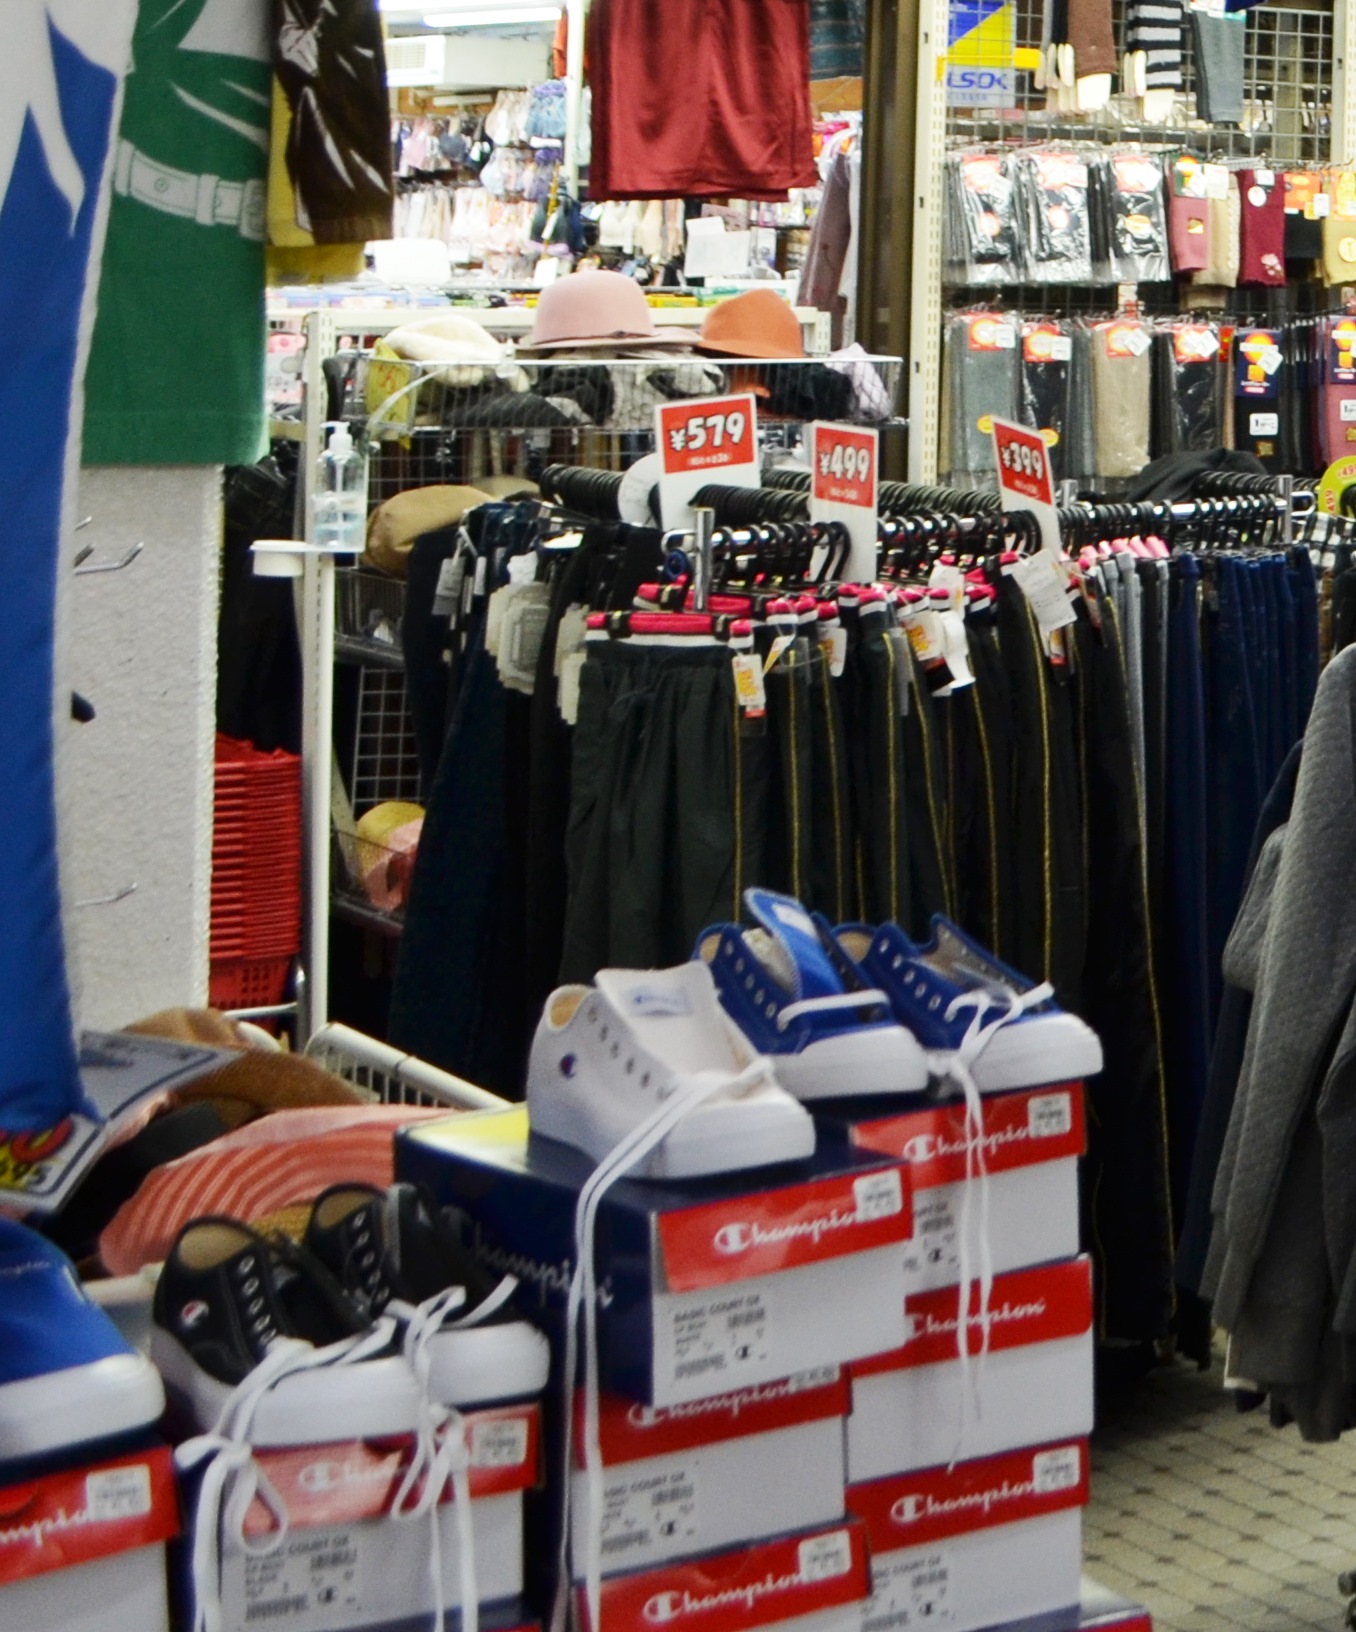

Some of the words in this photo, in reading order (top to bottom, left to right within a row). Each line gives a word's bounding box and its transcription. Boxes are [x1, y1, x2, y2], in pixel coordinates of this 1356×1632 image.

[669, 411, 746, 452] ¥579
[819, 445, 871, 484] ¥499
[1000, 443, 1044, 481] ¥399
